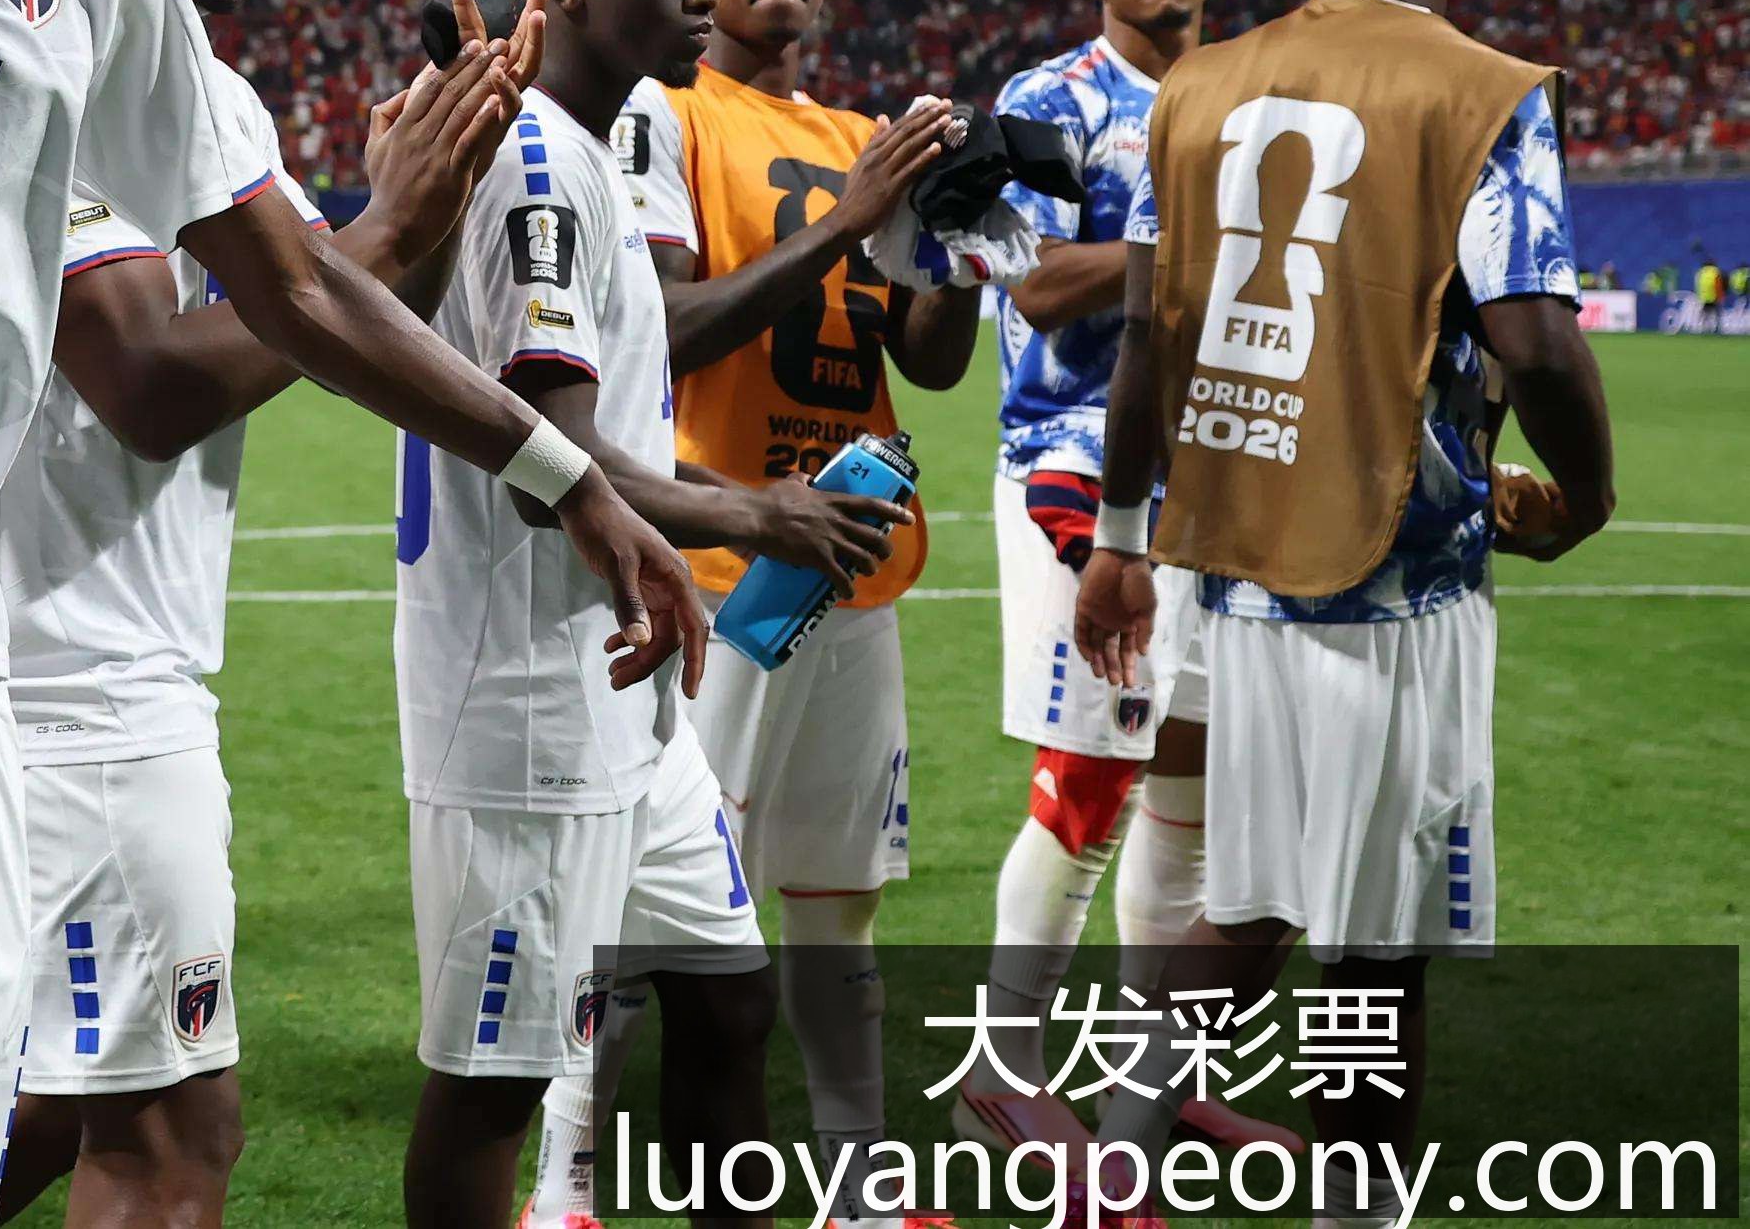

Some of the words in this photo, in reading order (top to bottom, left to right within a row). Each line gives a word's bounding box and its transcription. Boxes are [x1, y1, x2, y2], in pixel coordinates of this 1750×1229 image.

[71, 206, 104, 221] DEBUT
[540, 310, 570, 321] DEBUT
[1223, 317, 1292, 353] FIFA
[812, 356, 862, 390] FIFA
[1188, 376, 1272, 412] ORLD
[1273, 391, 1306, 420] CUP
[768, 415, 848, 443] WORLD
[765, 444, 833, 479] 20
[849, 461, 870, 480] 21
[179, 960, 221, 982] FCF
[579, 973, 613, 989] FCF
